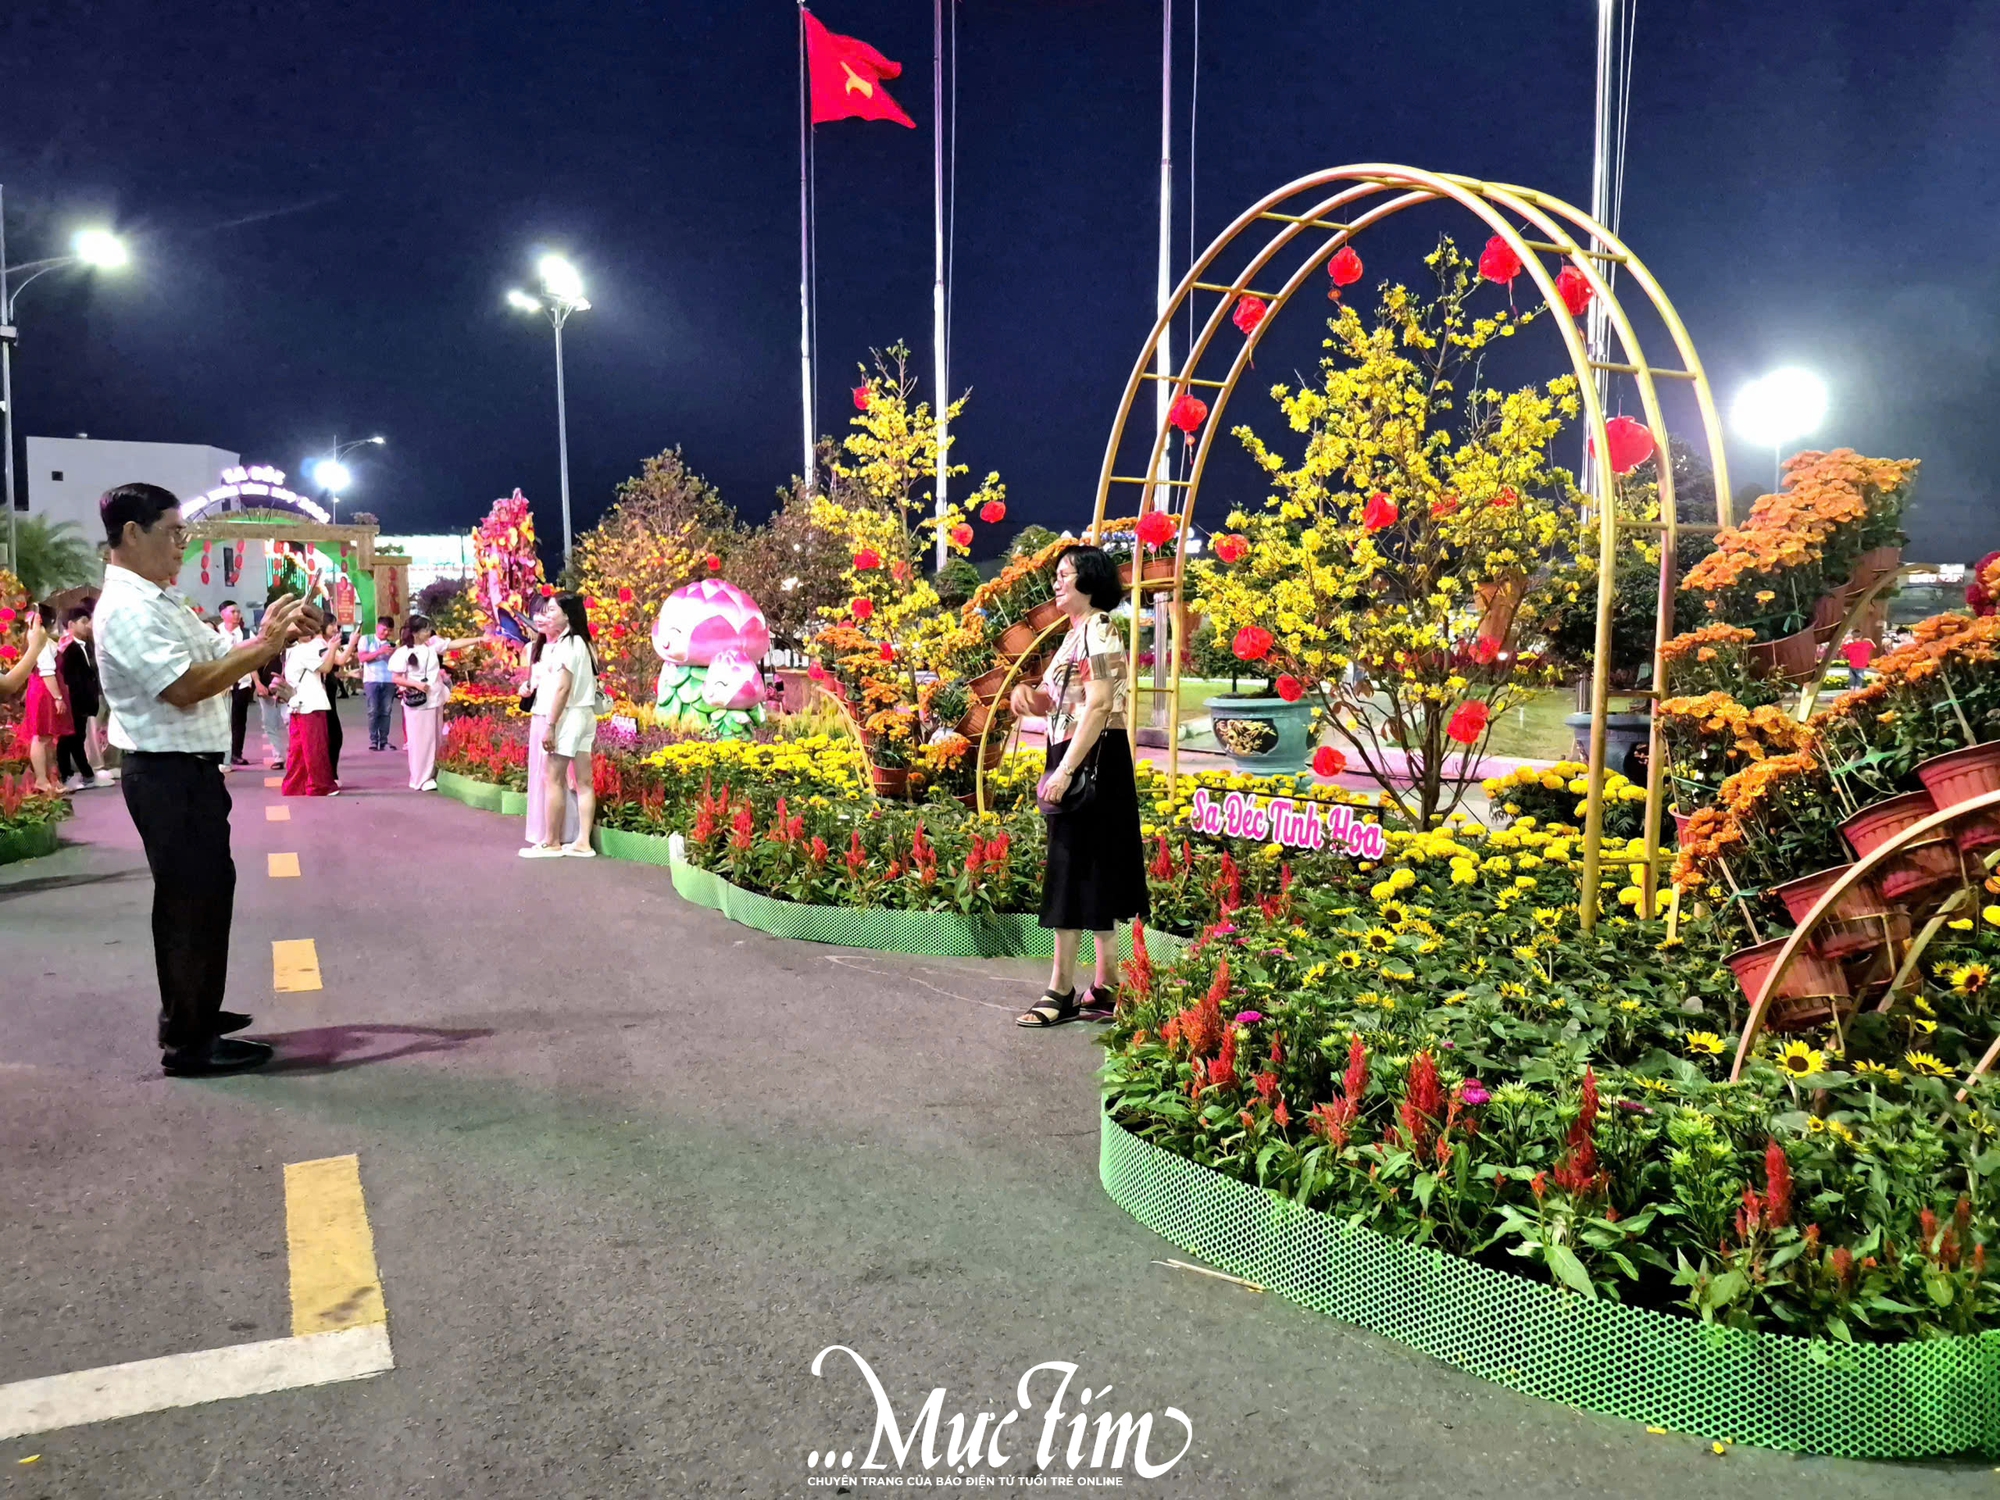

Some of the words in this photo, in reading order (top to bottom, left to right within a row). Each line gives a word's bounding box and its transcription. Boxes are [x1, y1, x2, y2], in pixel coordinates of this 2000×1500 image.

[1191, 788, 1222, 834] Sa
[1224, 791, 1268, 841] Đéc
[1268, 797, 1324, 850] Tinh
[1326, 804, 1386, 860] Hoa
